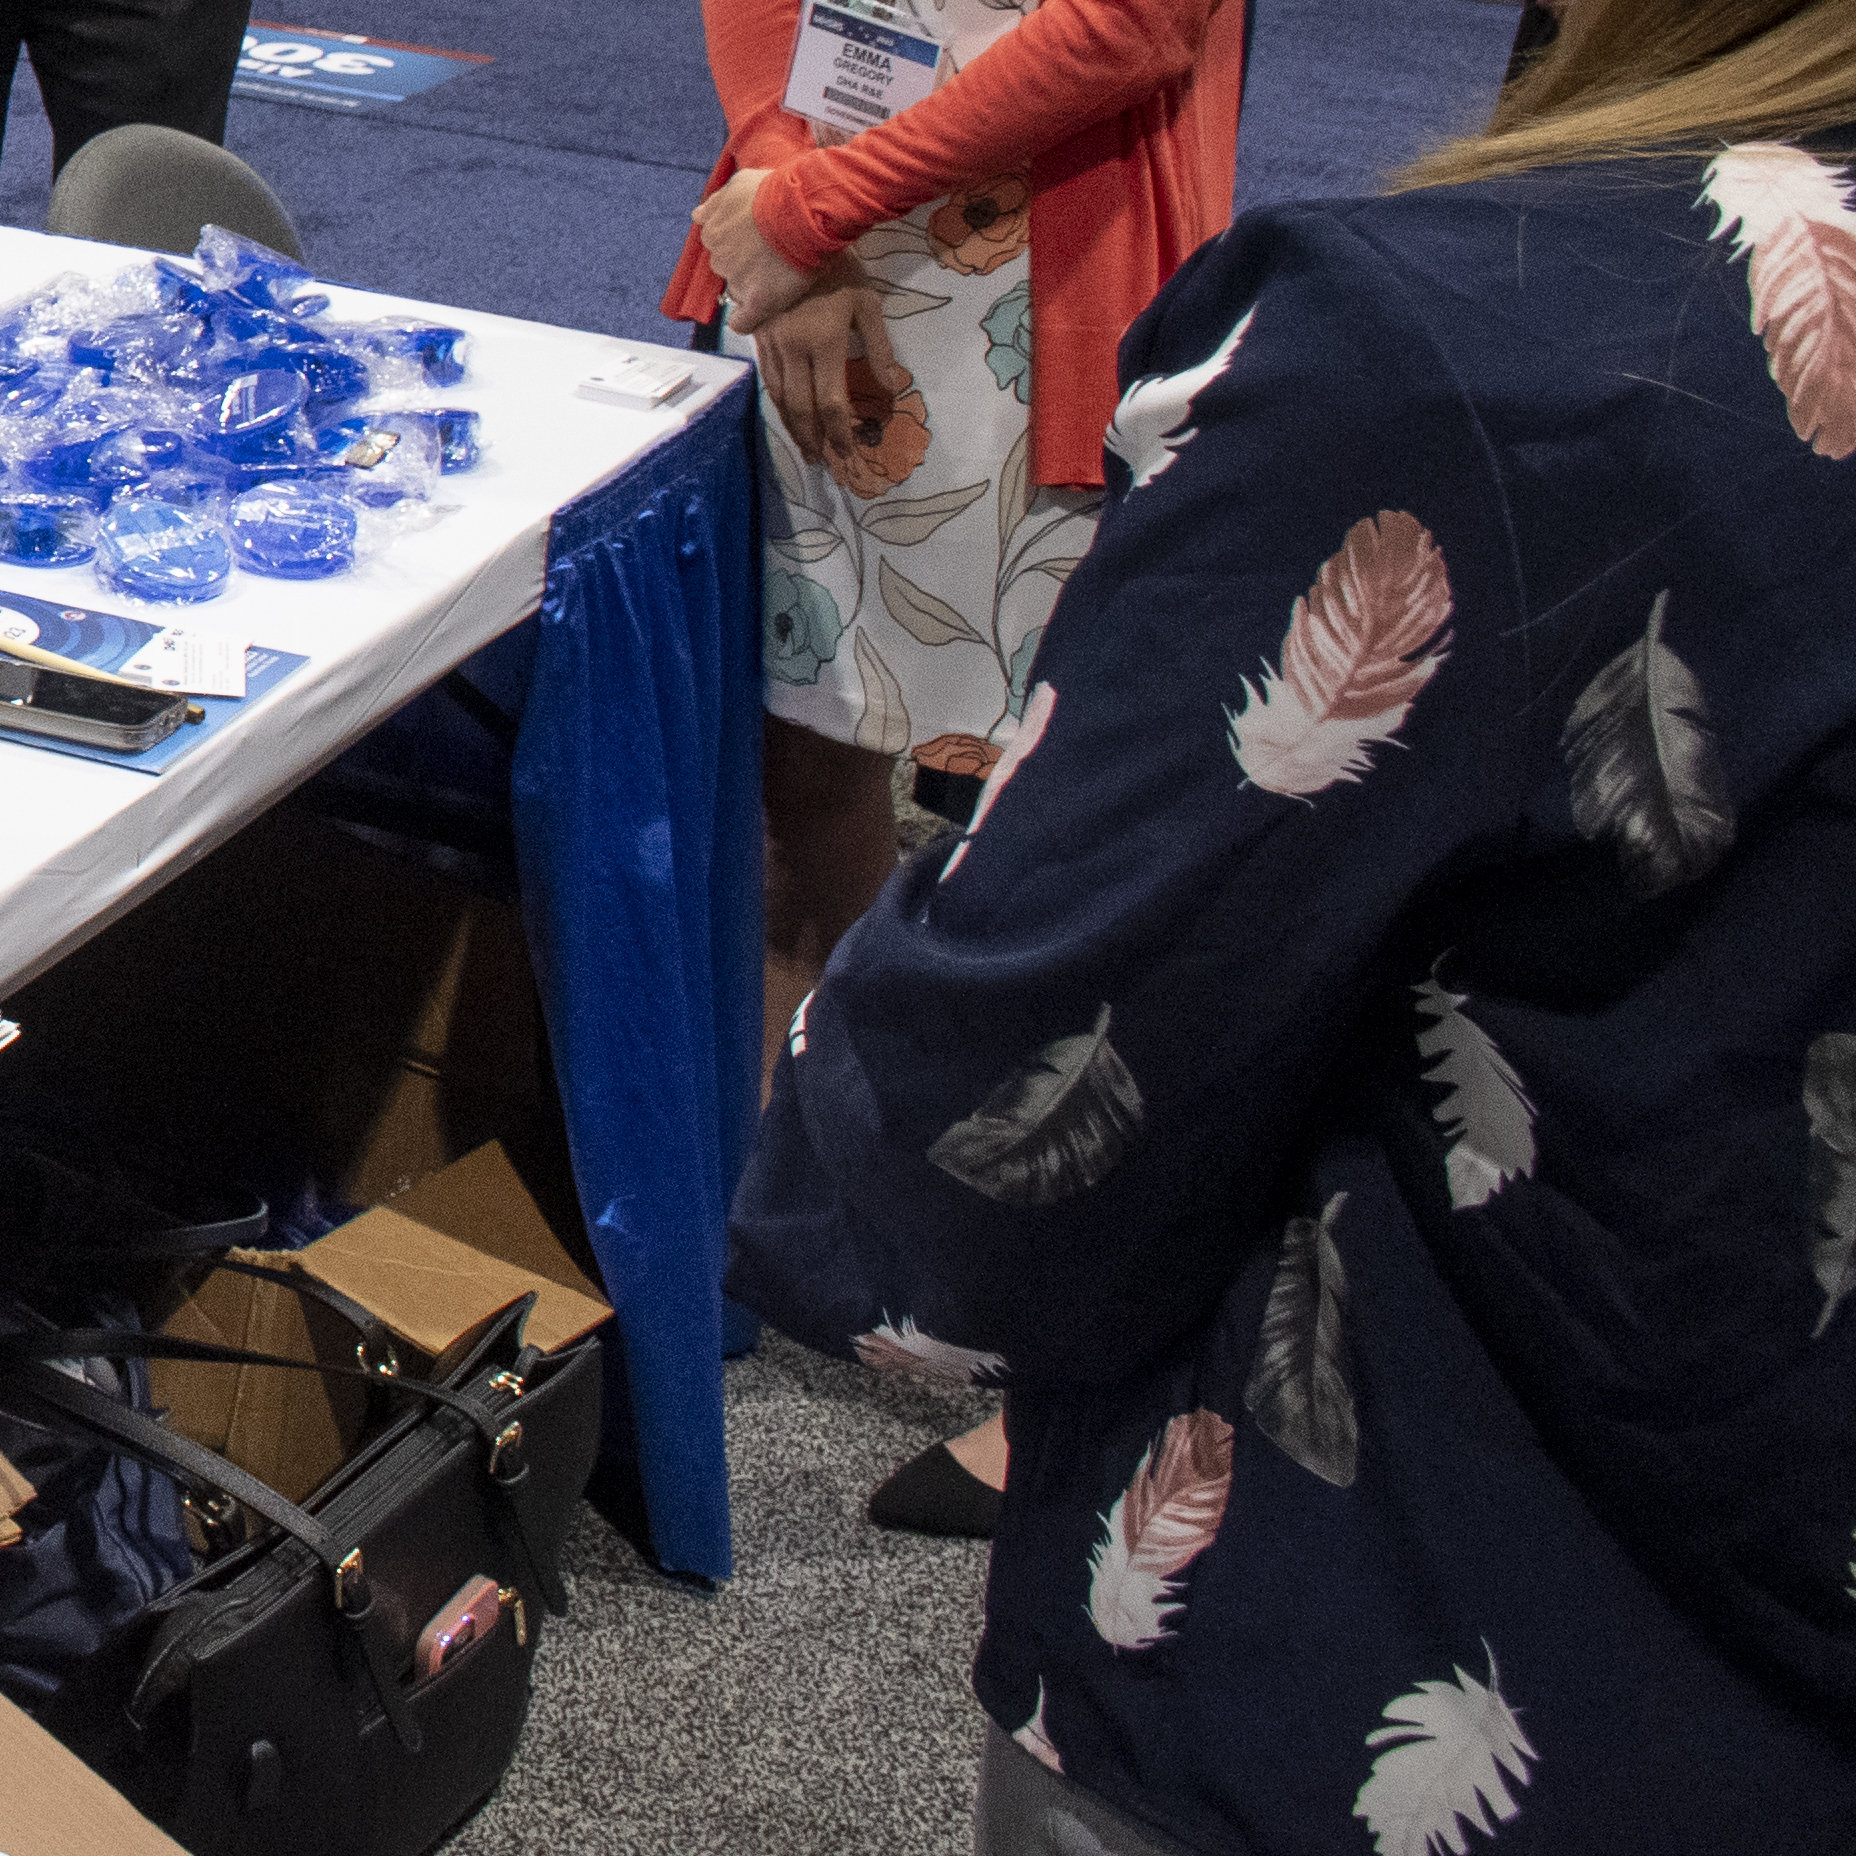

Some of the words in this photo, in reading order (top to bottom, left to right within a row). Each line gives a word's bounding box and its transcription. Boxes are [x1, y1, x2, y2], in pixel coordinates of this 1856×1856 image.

[241, 35, 395, 76] 30
[843, 43, 892, 72] EMMA
[833, 57, 894, 86] GREGORY
